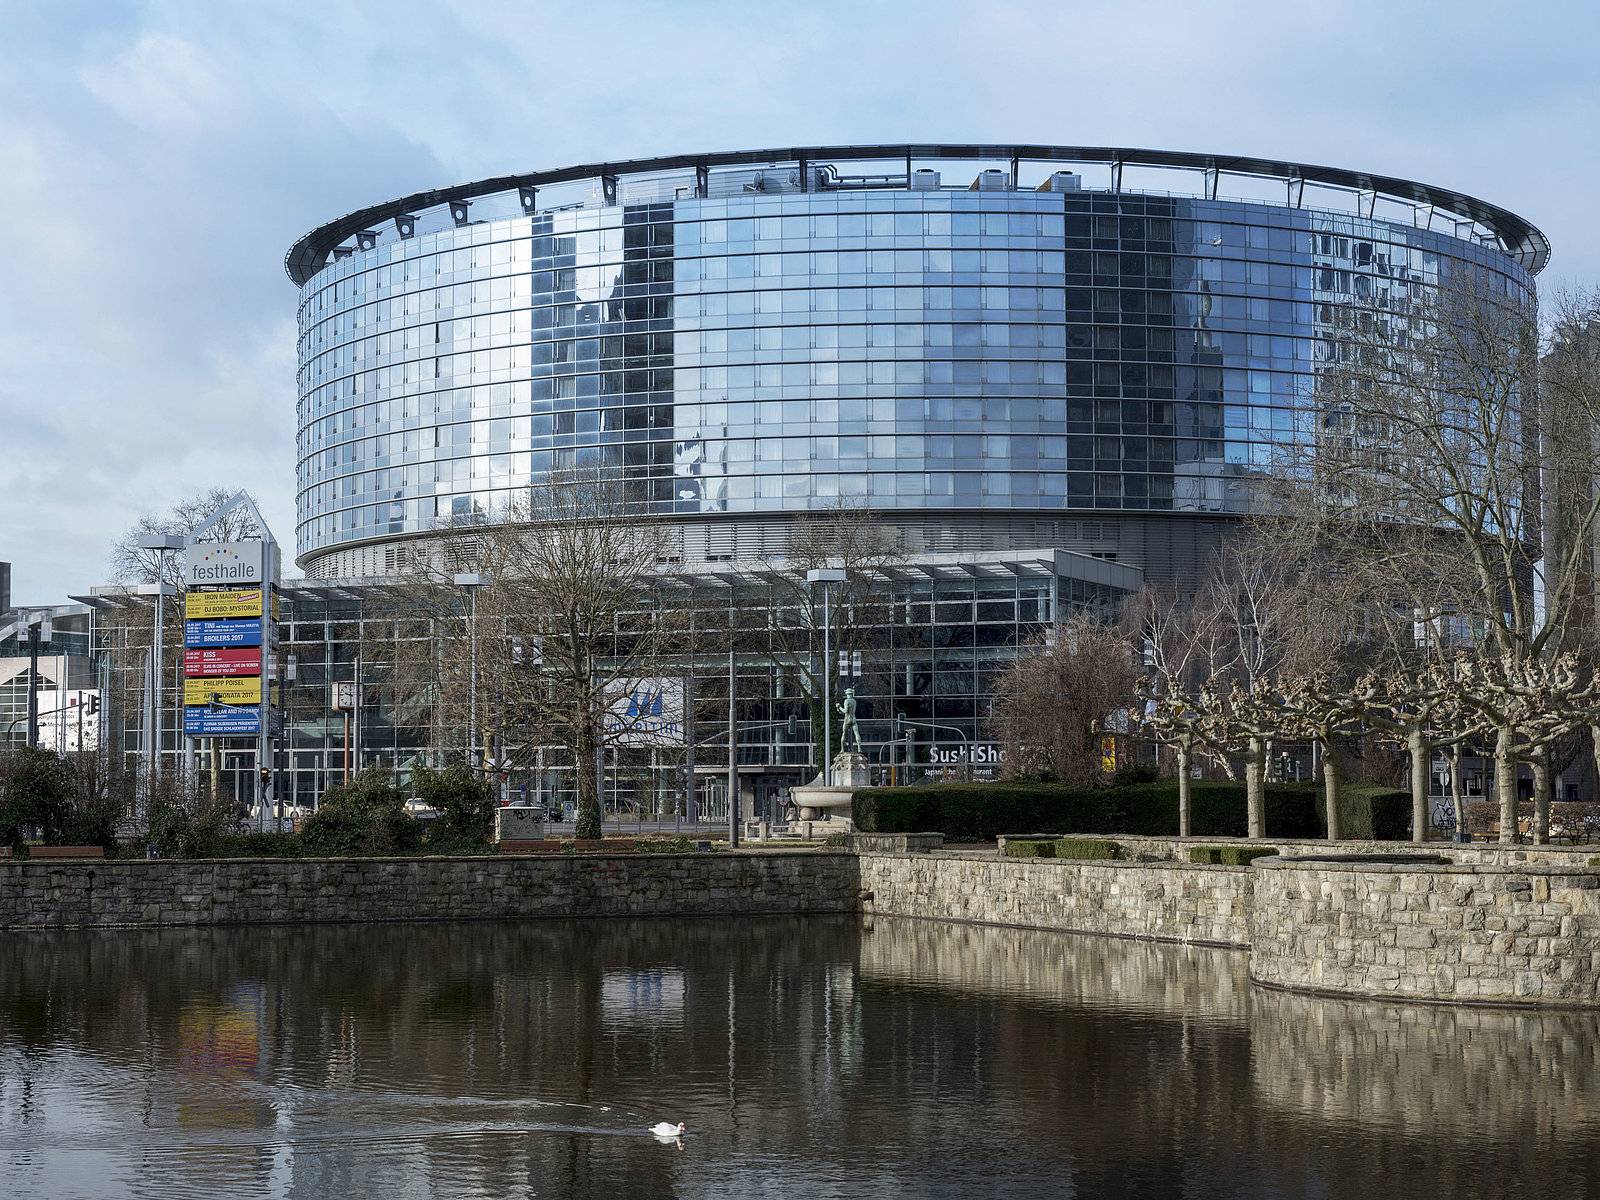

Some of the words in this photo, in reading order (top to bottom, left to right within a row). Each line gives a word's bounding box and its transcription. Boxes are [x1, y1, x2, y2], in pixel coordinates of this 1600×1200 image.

[192, 563, 254, 579] festhalle
[219, 592, 241, 600] MAIDEN
[229, 604, 259, 612] MYSTORIAL
